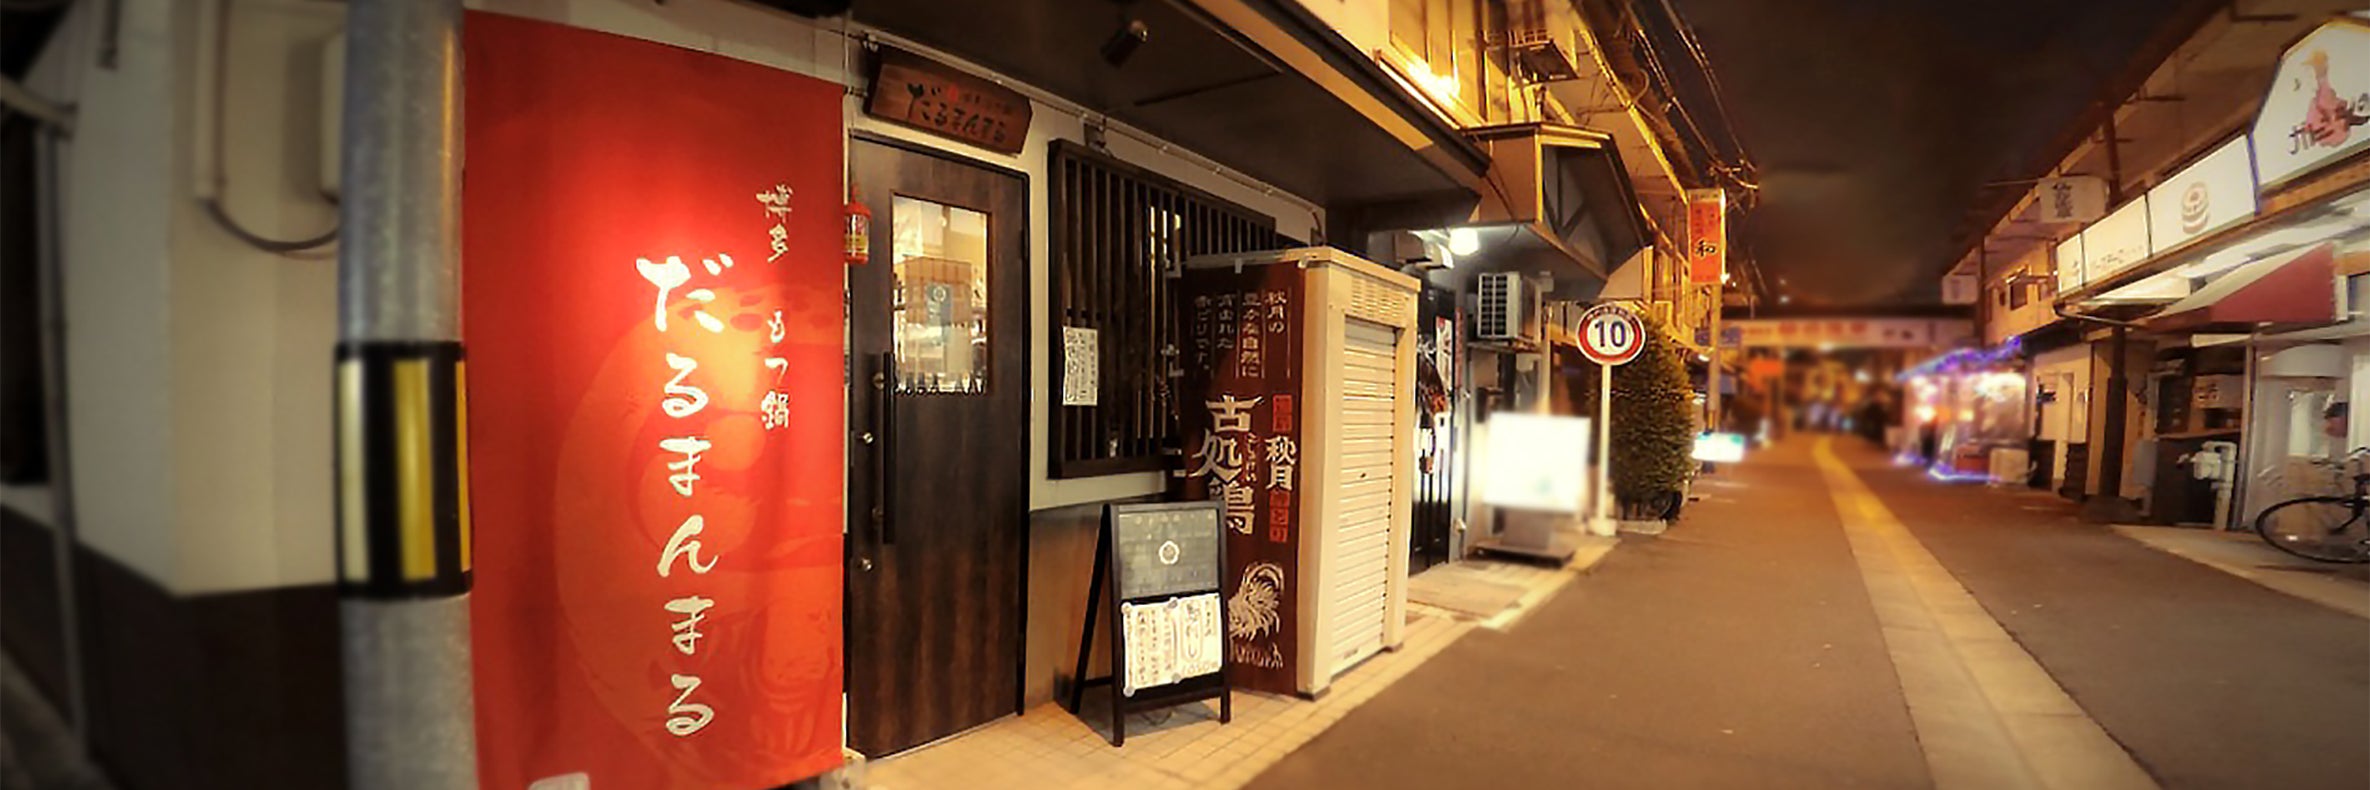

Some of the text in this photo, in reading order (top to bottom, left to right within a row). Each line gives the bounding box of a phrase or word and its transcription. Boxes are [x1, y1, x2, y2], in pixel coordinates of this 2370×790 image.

[1696, 239, 1716, 257] 和
[756, 184, 793, 430] 博多 もつ鍋
[1241, 292, 1261, 377] 豊かな自然に
[1264, 291, 1287, 333] 秋月の
[1594, 319, 1626, 348] 10
[636, 252, 734, 738] だるまんまる
[1189, 395, 1264, 534] 古処鶏
[1265, 435, 1296, 490] 秋月
